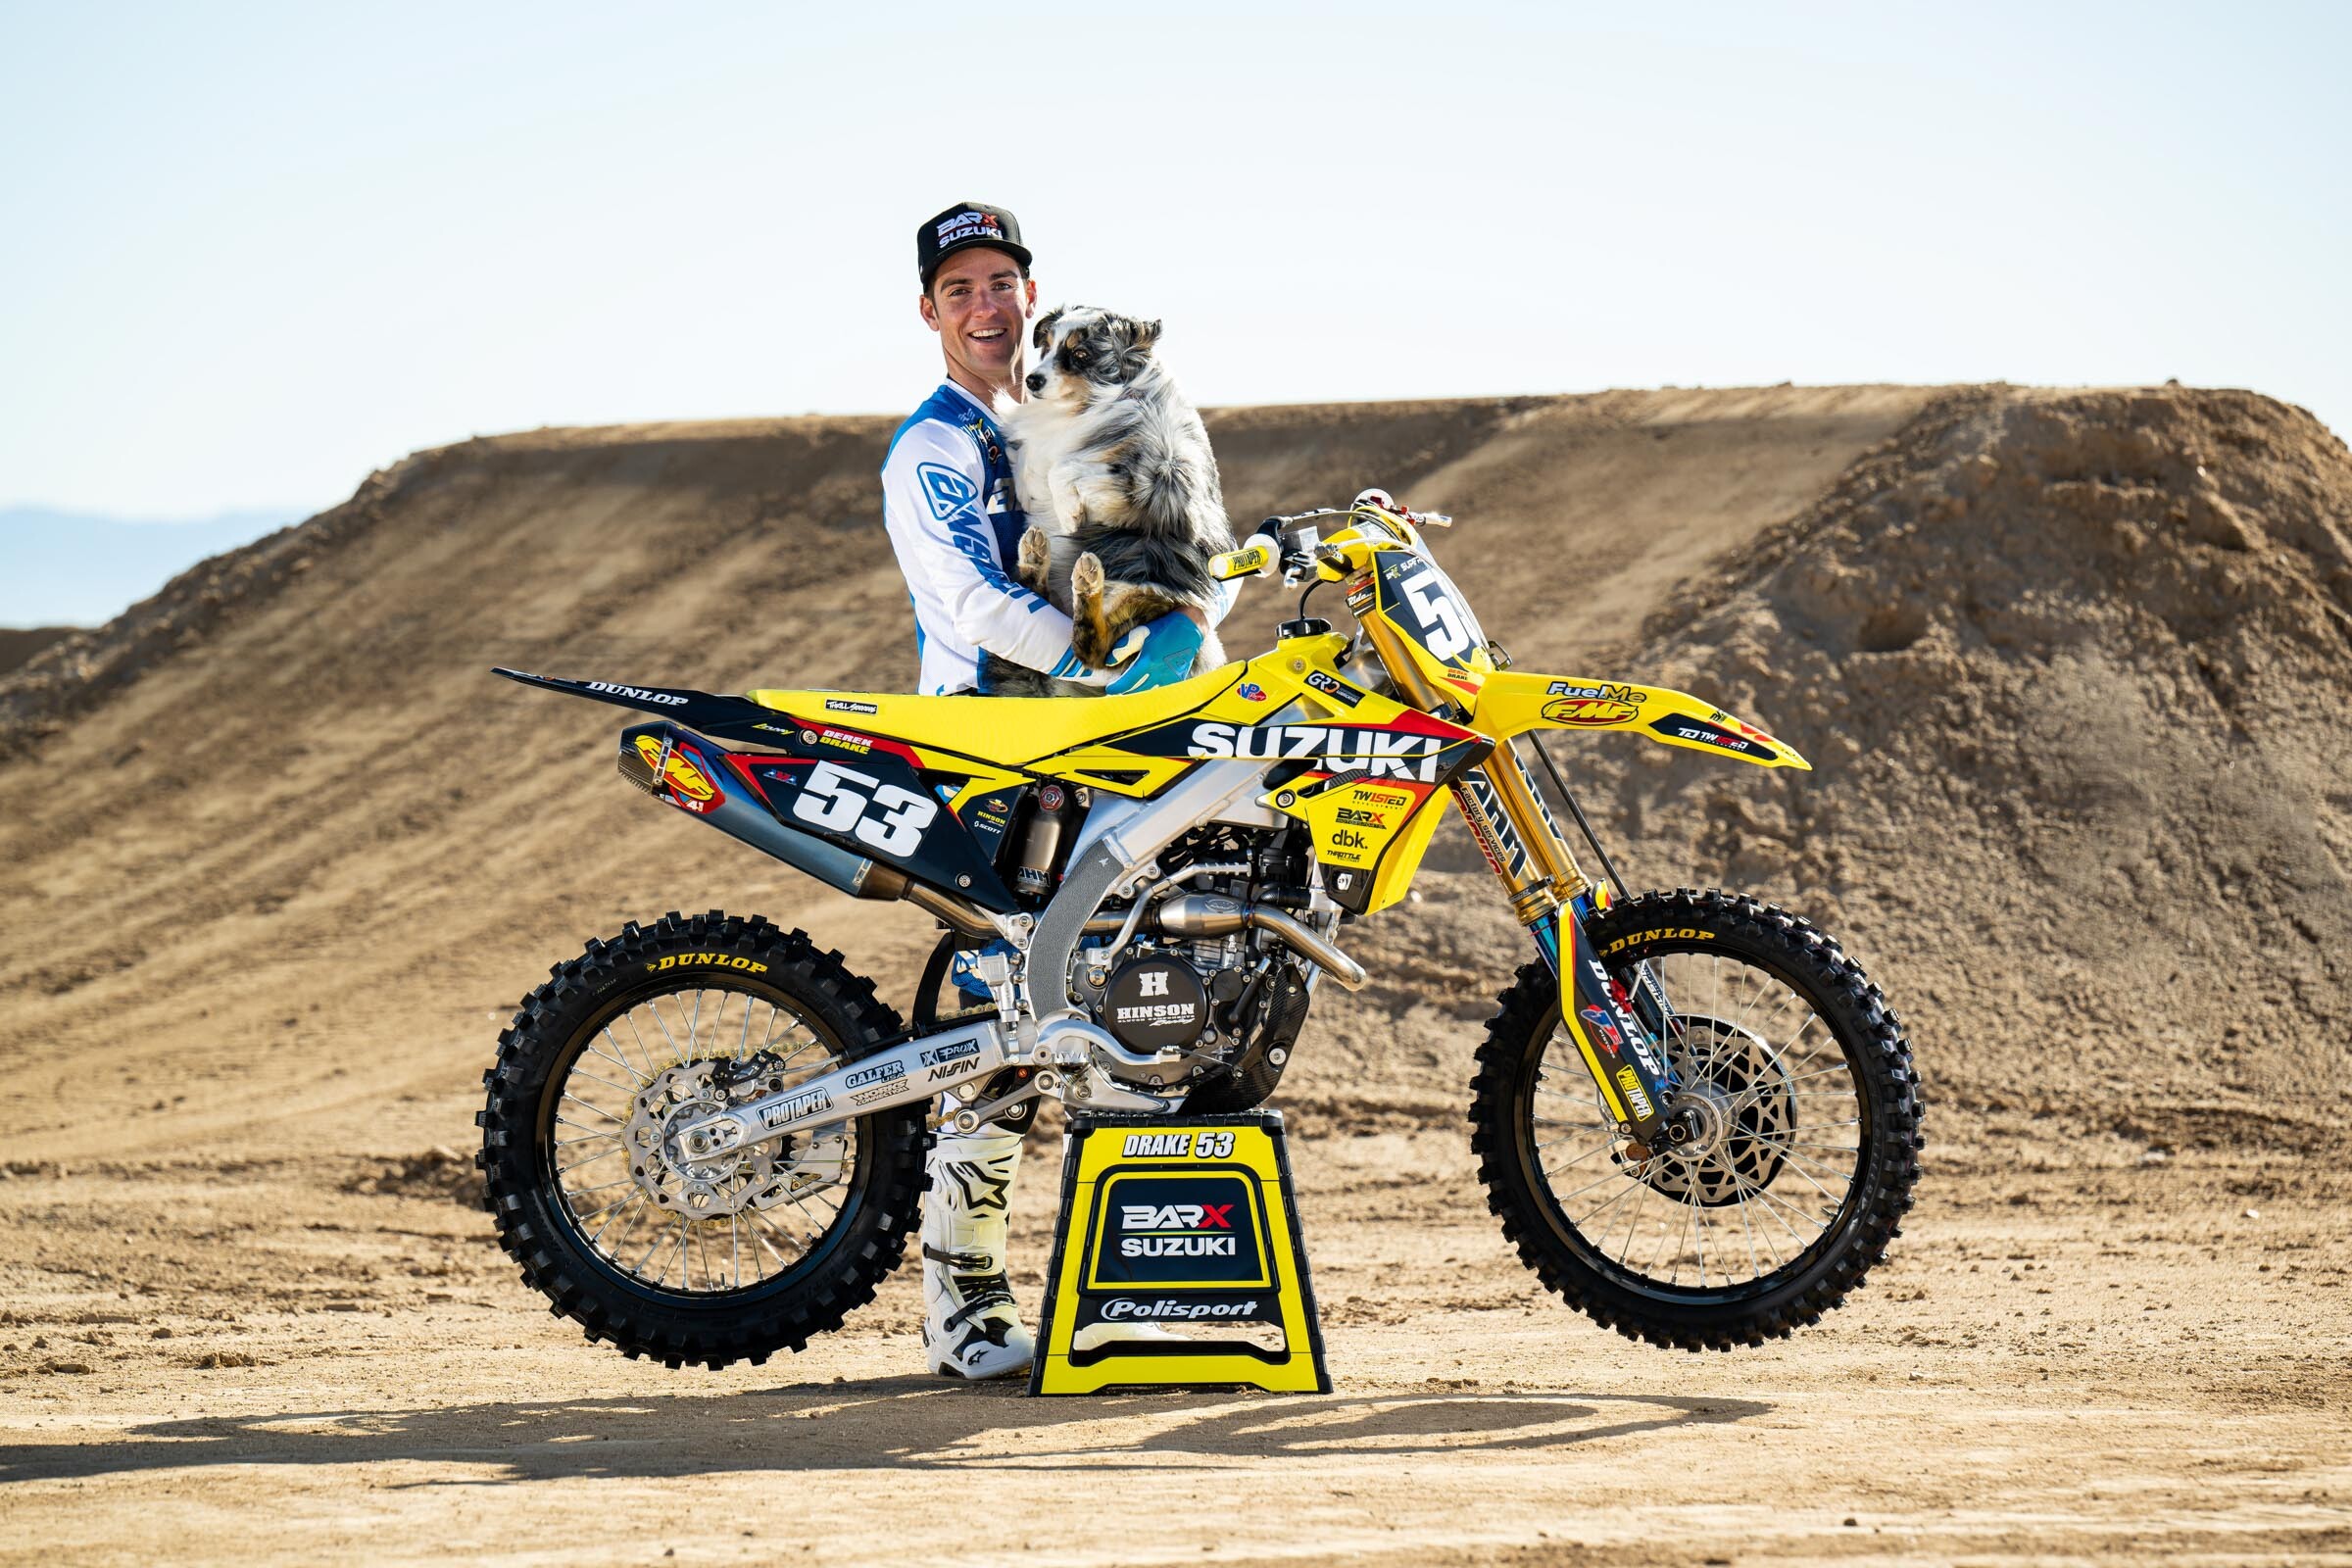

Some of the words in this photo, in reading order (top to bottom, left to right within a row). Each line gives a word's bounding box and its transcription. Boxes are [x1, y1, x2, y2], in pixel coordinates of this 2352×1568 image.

[936, 212, 998, 237] BARX
[939, 226, 1003, 248] SUZUKI
[586, 681, 689, 706] DUNLOP
[1239, 683, 1260, 699] VP
[1542, 700, 1640, 719] FMF
[819, 736, 870, 755] DRAKE
[823, 729, 873, 747] DEREK
[1187, 722, 1442, 783] SUZUKI
[793, 759, 938, 858] 53
[977, 810, 1006, 825] HINSON
[1337, 807, 1386, 824] BARX
[979, 823, 1002, 834] SCOTT
[1460, 786, 1485, 823] Factory
[1481, 823, 1507, 863] services
[1326, 850, 1362, 861] THROTTLE
[1610, 927, 1715, 954] DUNLOP
[658, 953, 768, 973] DUNLOP
[1139, 971, 1169, 997] H
[1116, 1003, 1195, 1020] HINSON
[1598, 1028, 1616, 1059] PISTONS
[845, 1059, 905, 1089] GALFER
[881, 1072, 906, 1083] USA
[927, 1055, 980, 1082] NISSIN
[1618, 1068, 1654, 1119] PROTAPER
[762, 1091, 828, 1127] PROTAPER
[1122, 1134, 1190, 1158] DRAKE
[1194, 1131, 1236, 1159] 53
[1120, 1204, 1235, 1229] BARX
[1120, 1237, 1236, 1257] SUZUKI
[1101, 1298, 1258, 1320] Polisport
